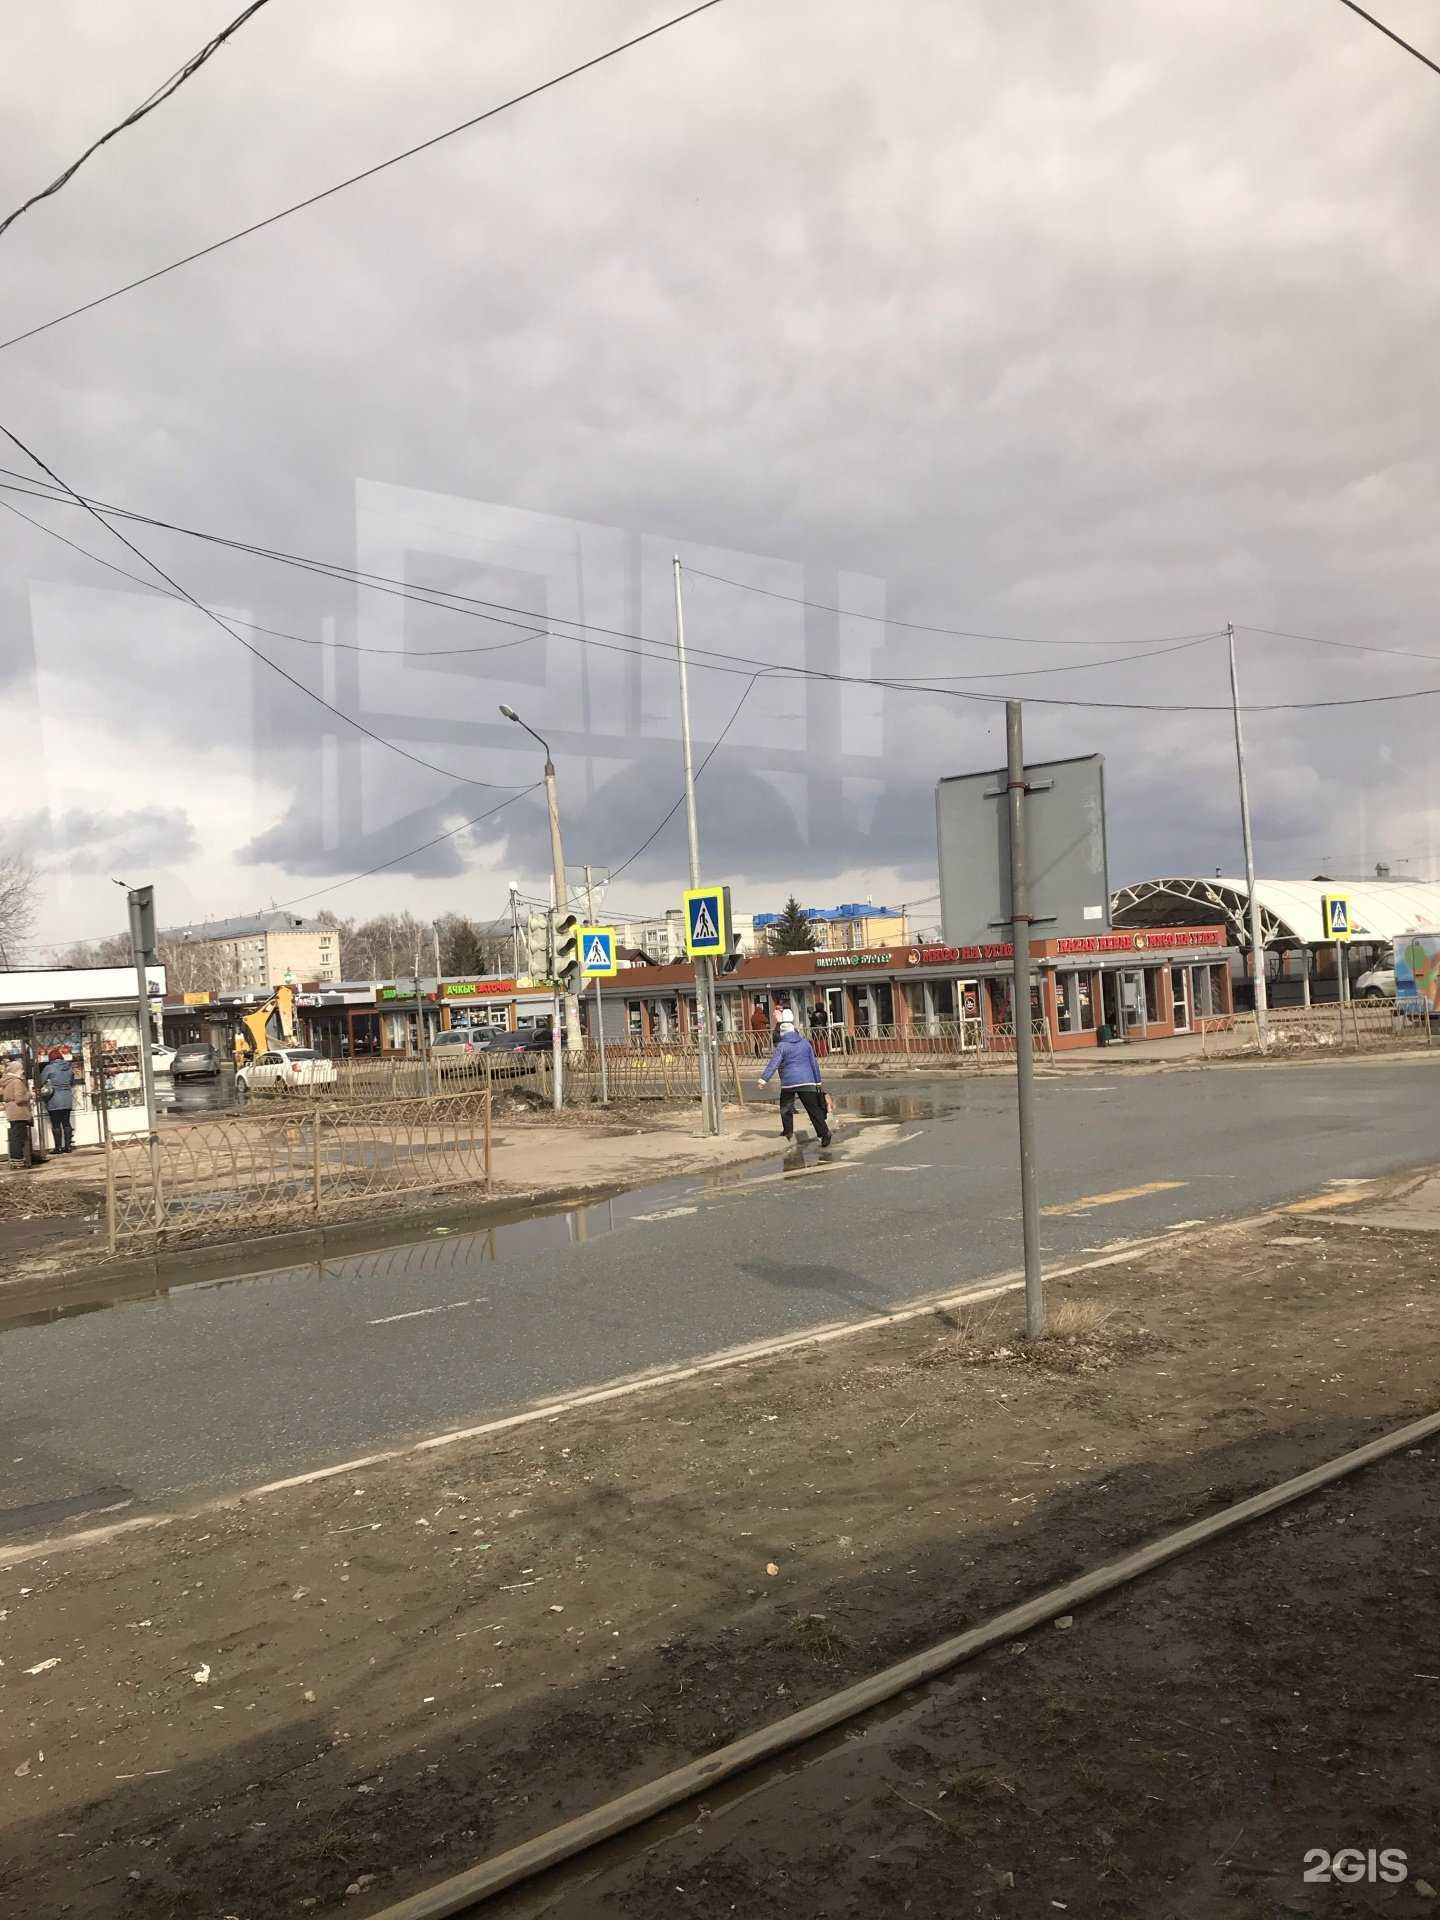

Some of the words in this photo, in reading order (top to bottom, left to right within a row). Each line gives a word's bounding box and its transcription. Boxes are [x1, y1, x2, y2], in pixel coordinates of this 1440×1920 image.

[1057, 937, 1096, 953] KAZAN
[1097, 935, 1133, 951] KEBAB
[922, 948, 959, 961] МЯСО
[961, 946, 982, 960] НА
[447, 983, 476, 994] АЧКЫЧ
[477, 982, 513, 994] ЗАТОЧКА
